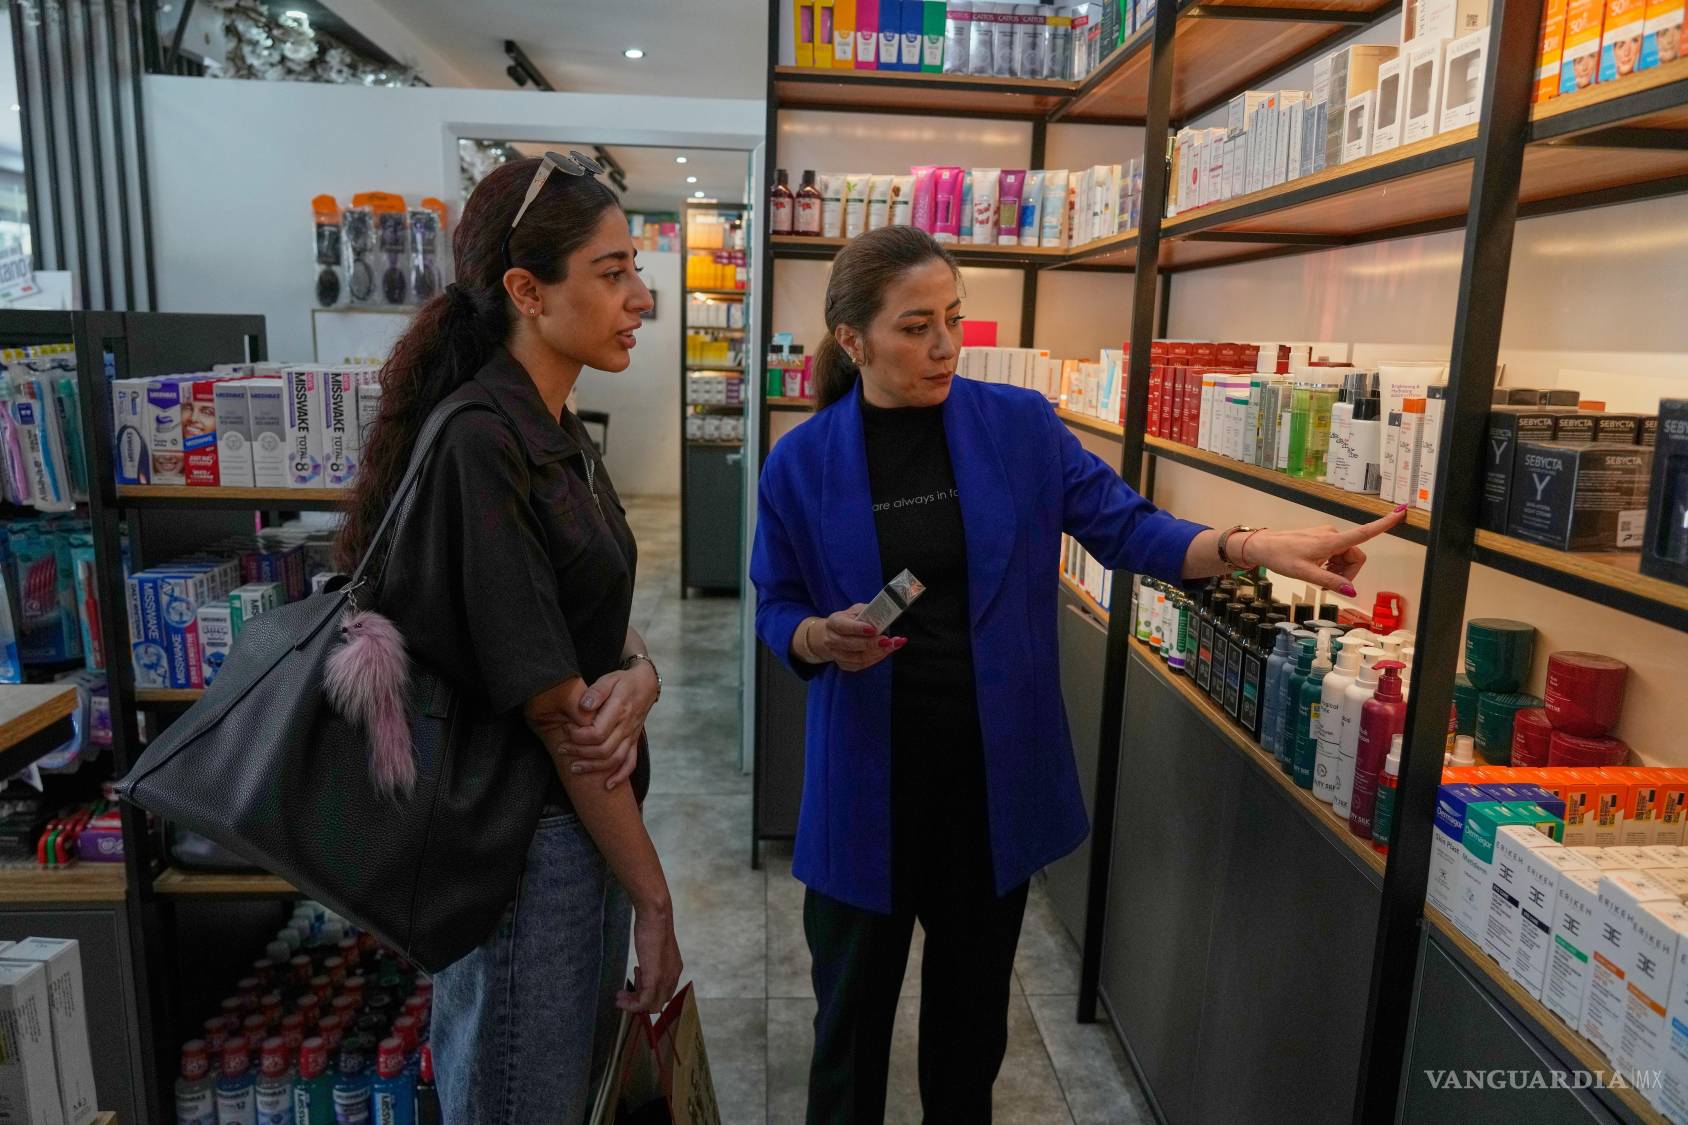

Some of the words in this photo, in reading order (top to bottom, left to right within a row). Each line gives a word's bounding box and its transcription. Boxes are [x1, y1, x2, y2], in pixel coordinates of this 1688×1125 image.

[295, 372, 309, 433] MISSWAKE
[331, 373, 345, 433] MISSWAKE
[1518, 418, 1552, 426] SEBYCTA
[1559, 419, 1593, 428] SEBYCTA
[1600, 420, 1635, 428] SEBYCTA
[299, 435, 308, 462] TOTAL
[1492, 440, 1508, 464] Y
[295, 462, 310, 472] 8
[1525, 454, 1563, 472] SEBYCTA
[1605, 456, 1642, 465] SEBYCTA
[1532, 473, 1551, 500] Y
[872, 502, 890, 512] are
[893, 493, 934, 508] always
[936, 490, 947, 500] in
[143, 582, 159, 639] MISSWAKE
[171, 634, 186, 684] MISSWAKE
[1437, 807, 1463, 829] Dermagor
[1465, 825, 1492, 848] Dermagor
[1496, 841, 1523, 864] ERIKEH
[1527, 866, 1554, 888] ERIKEH
[1559, 890, 1592, 916] ERIKEH
[1599, 894, 1634, 924] ERIKEH
[1633, 923, 1670, 954] ERIKEH
